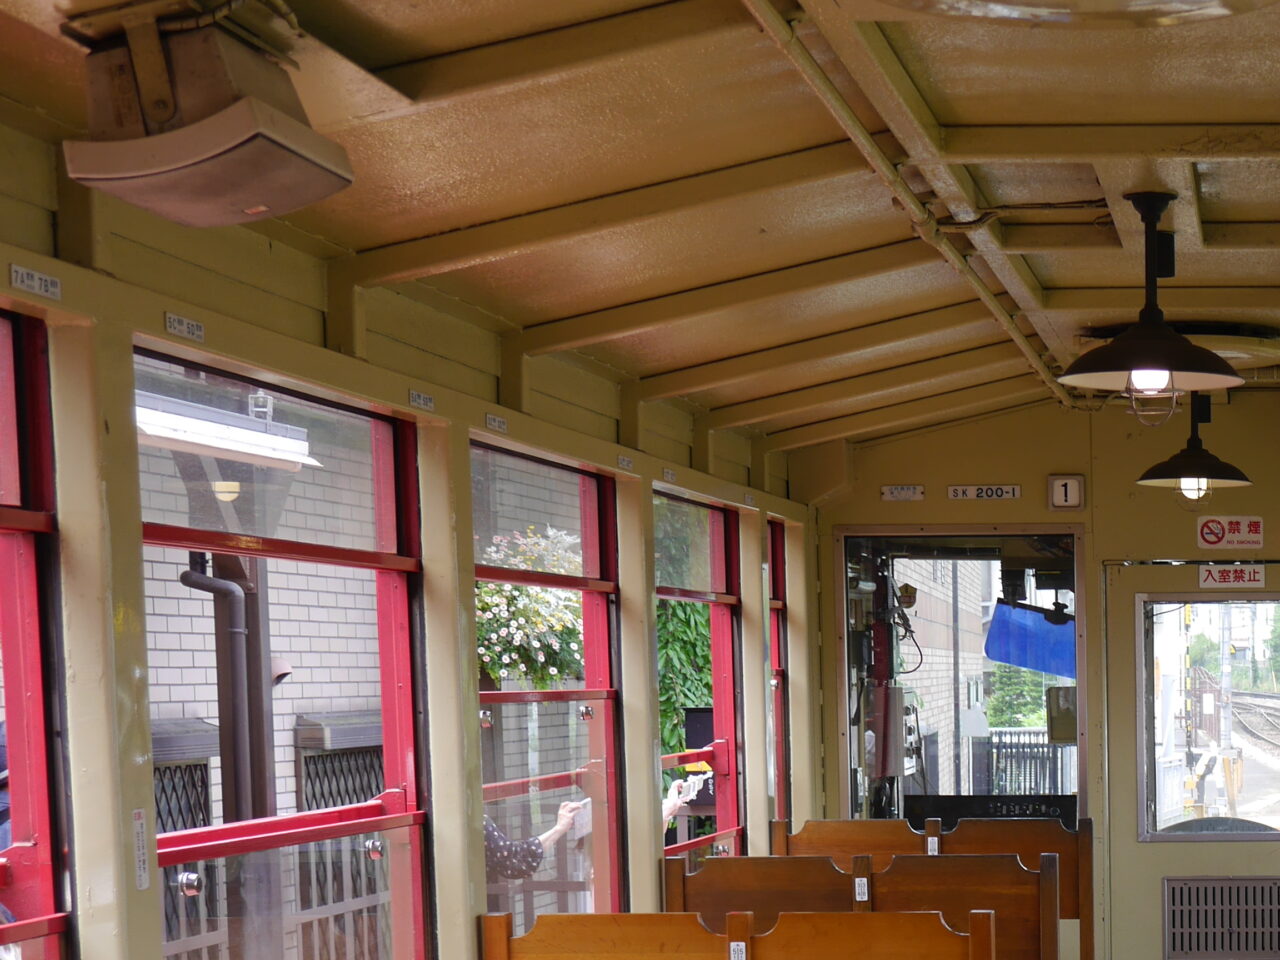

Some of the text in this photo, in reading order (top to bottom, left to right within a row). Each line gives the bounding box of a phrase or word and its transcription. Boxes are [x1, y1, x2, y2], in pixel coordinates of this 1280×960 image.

[952, 488, 968, 498] SK
[1061, 482, 1068, 503] 1
[1228, 520, 1261, 534] 禁煙
[1203, 568, 1260, 583] 入室禁止
